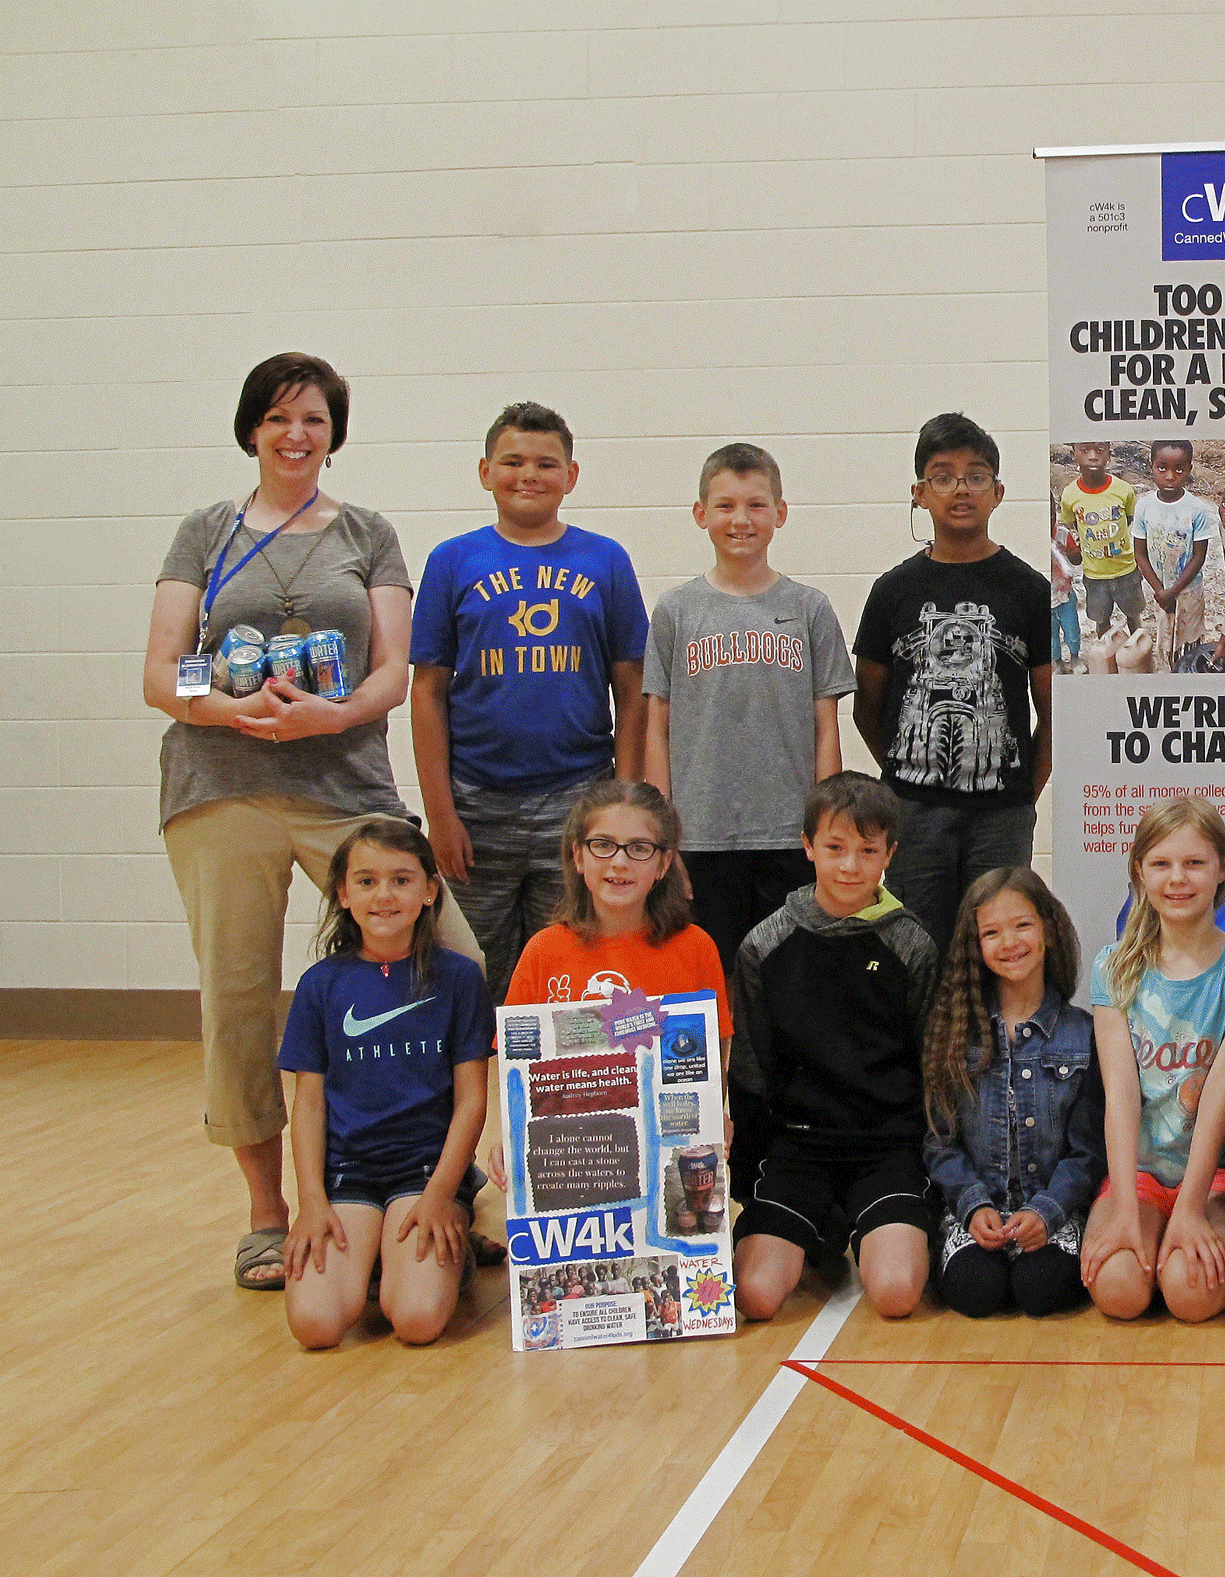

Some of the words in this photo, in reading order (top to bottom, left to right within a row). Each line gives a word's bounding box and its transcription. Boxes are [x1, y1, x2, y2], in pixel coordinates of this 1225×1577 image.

[1089, 202, 1115, 212] cW4k
[1117, 202, 1126, 211] is
[1089, 214, 1096, 222] a
[1098, 213, 1126, 222] 501c3
[1087, 223, 1128, 233] nonprofit
[1154, 284, 1222, 317] TOO
[1110, 353, 1175, 386] FOR
[1186, 353, 1211, 385] A
[1084, 387, 1199, 426] CLEAN,
[473, 567, 524, 602] THE
[536, 565, 595, 600] NEW
[480, 648, 504, 676] IN
[514, 645, 582, 673] TOWN
[686, 630, 804, 677] BULLDOGS
[1107, 732, 1150, 764] TO
[1083, 784, 1111, 798] 95%
[1115, 784, 1127, 798] of
[1131, 784, 1144, 798] all
[1083, 803, 1111, 816] from
[1115, 803, 1135, 816] the
[1083, 821, 1115, 836] helps
[1119, 821, 1139, 835] fun
[1083, 840, 1117, 853] water
[346, 1040, 442, 1062] ATHLETE
[529, 1073, 561, 1083] Water
[562, 1070, 570, 1080] is
[571, 1069, 591, 1078] life,
[592, 1066, 610, 1077] and
[611, 1065, 638, 1075] clean
[535, 1083, 565, 1093] water
[566, 1081, 597, 1091] means
[598, 1076, 632, 1088] health.
[549, 1134, 554, 1143] I
[555, 1133, 580, 1143] alone
[582, 1133, 614, 1143] cannot
[533, 1146, 565, 1157] change
[567, 1145, 583, 1154] the
[584, 1144, 612, 1154] world,
[614, 1143, 630, 1153] but
[543, 1158, 548, 1167] I
[549, 1159, 566, 1167] can
[568, 1157, 586, 1166] cast
[588, 1158, 594, 1166] a
[596, 1157, 620, 1165] stone
[537, 1171, 566, 1179] across
[568, 1168, 583, 1178] the
[585, 1169, 614, 1177] waters
[616, 1168, 626, 1176] to
[537, 1182, 564, 1190] create
[566, 1182, 591, 1191] many
[593, 1179, 627, 1191] ripples.
[508, 1212, 634, 1262] cW4k
[679, 1257, 723, 1269] WATER
[682, 1316, 734, 1331] WEDNESDAYS
